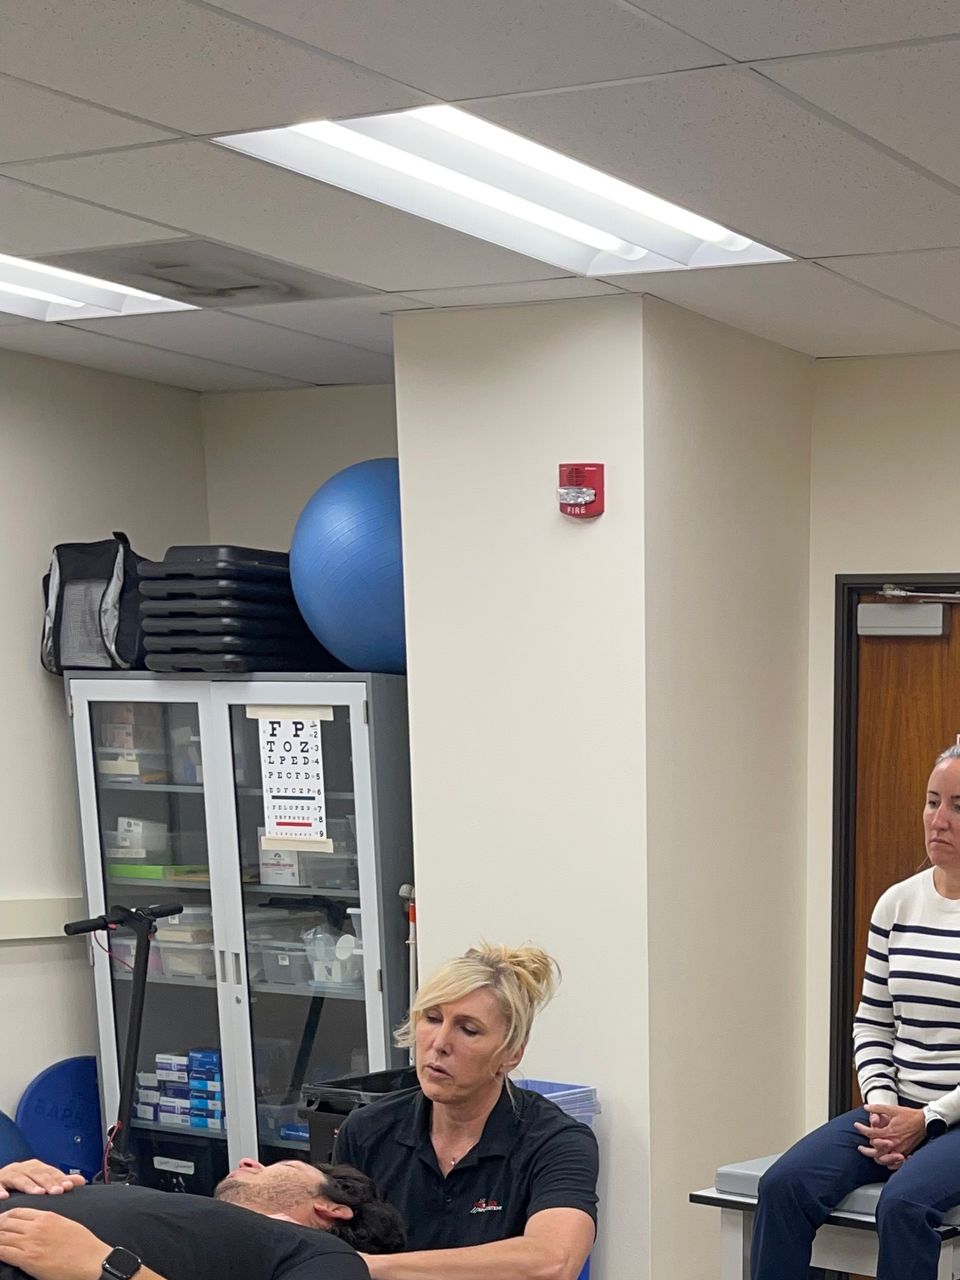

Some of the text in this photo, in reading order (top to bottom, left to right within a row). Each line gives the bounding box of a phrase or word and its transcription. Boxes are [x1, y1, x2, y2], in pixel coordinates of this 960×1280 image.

[567, 506, 586, 514] FIRE
[269, 721, 304, 737] F P
